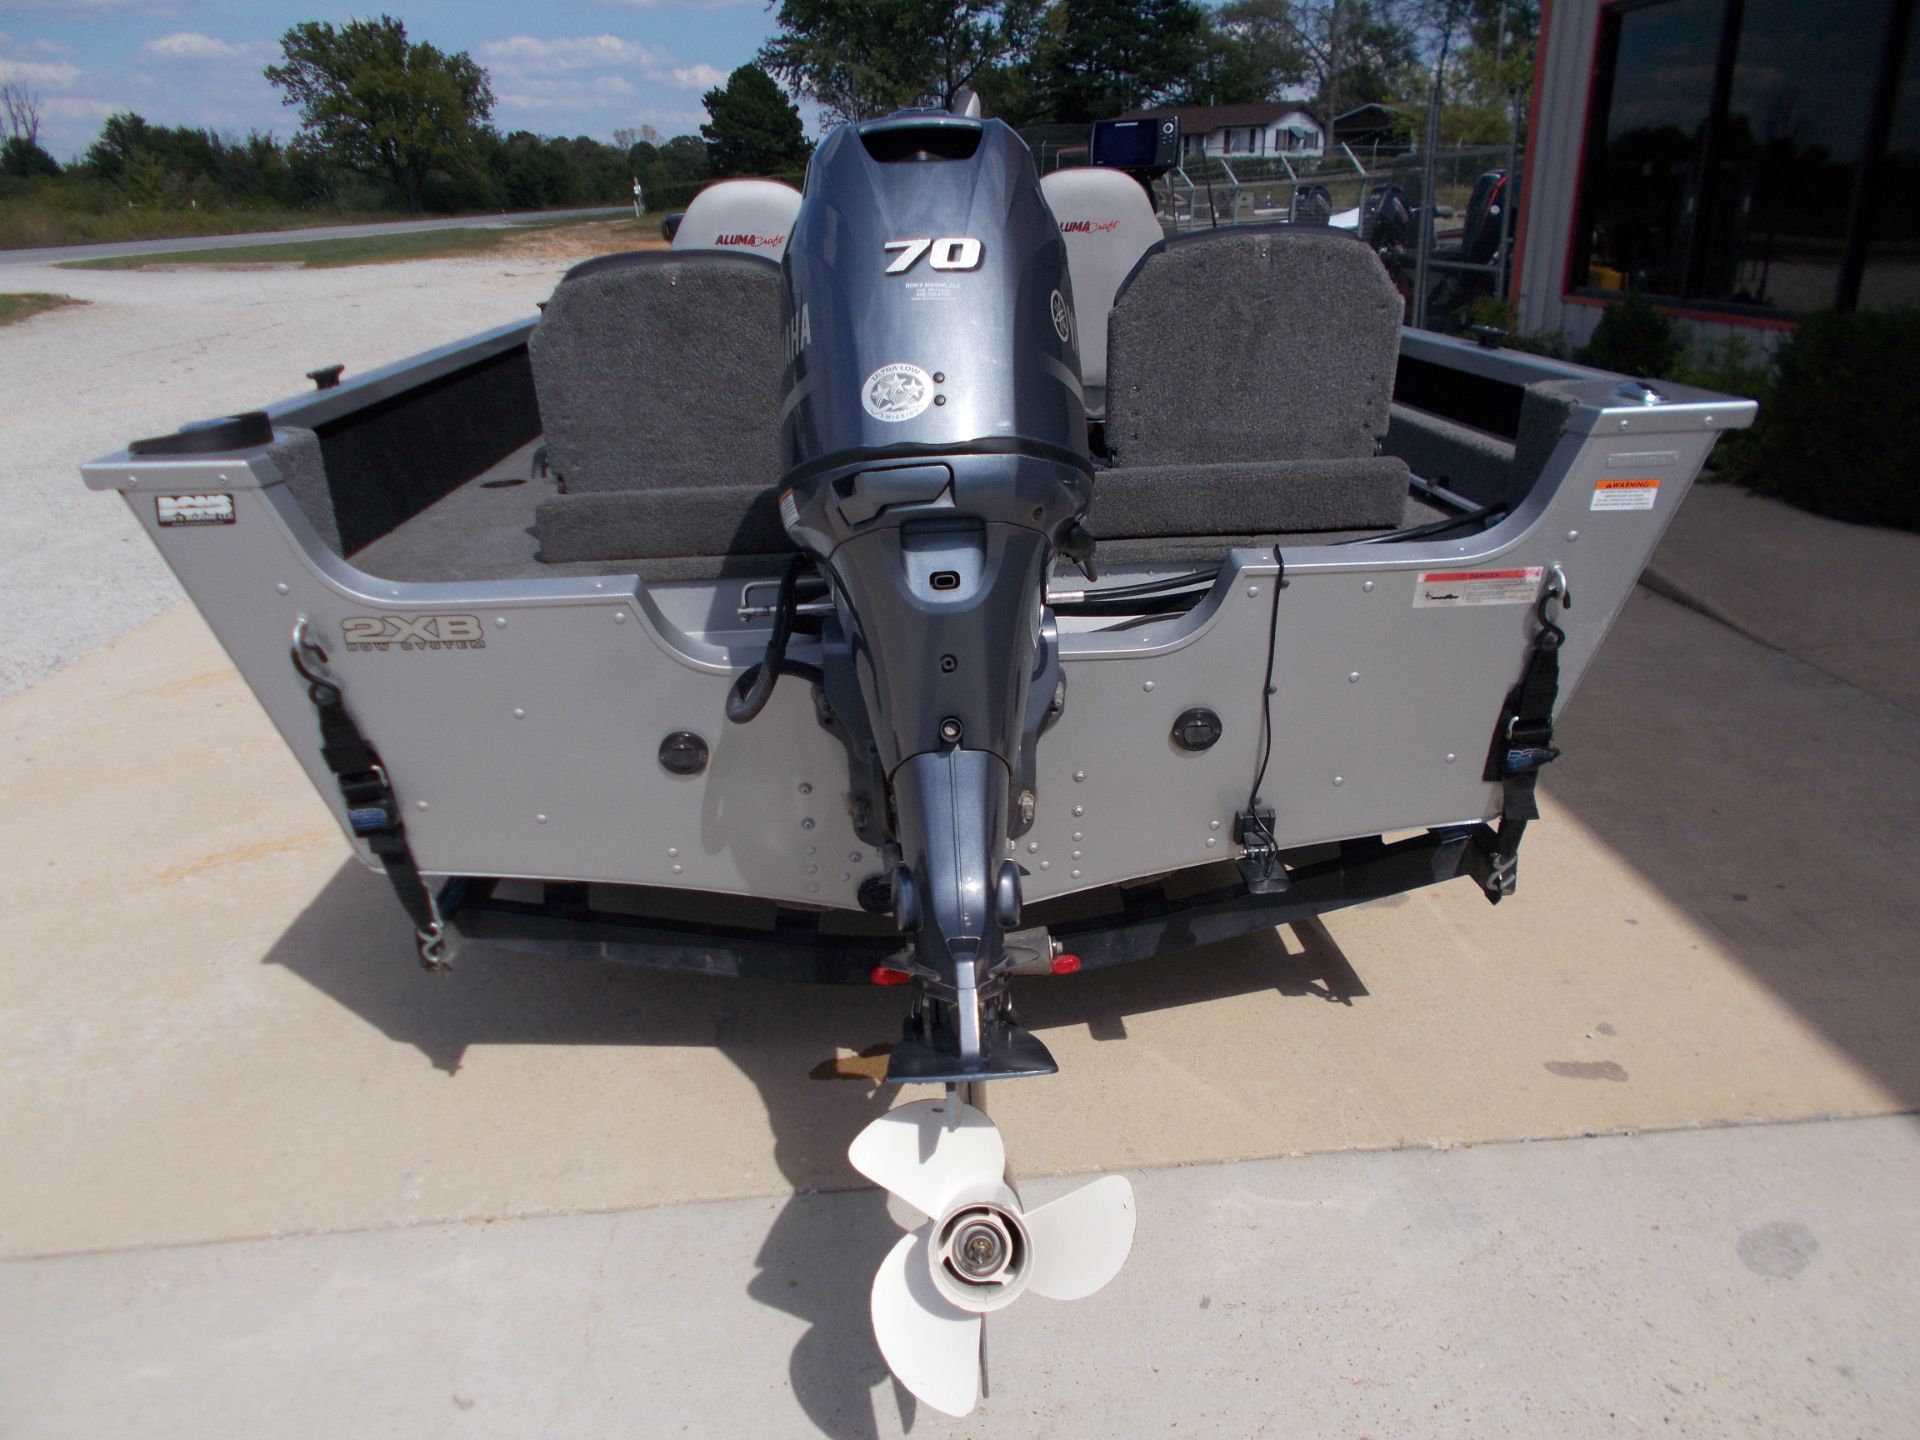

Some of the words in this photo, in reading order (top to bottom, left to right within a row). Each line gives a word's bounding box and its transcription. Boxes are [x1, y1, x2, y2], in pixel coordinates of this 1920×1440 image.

[1059, 220, 1119, 234] LUMACraft
[884, 238, 984, 274] 70
[900, 365, 921, 375] LOW
[1613, 481, 1650, 489] WARNING
[341, 615, 484, 643] 2XB
[401, 640, 486, 651] SYSTEM
